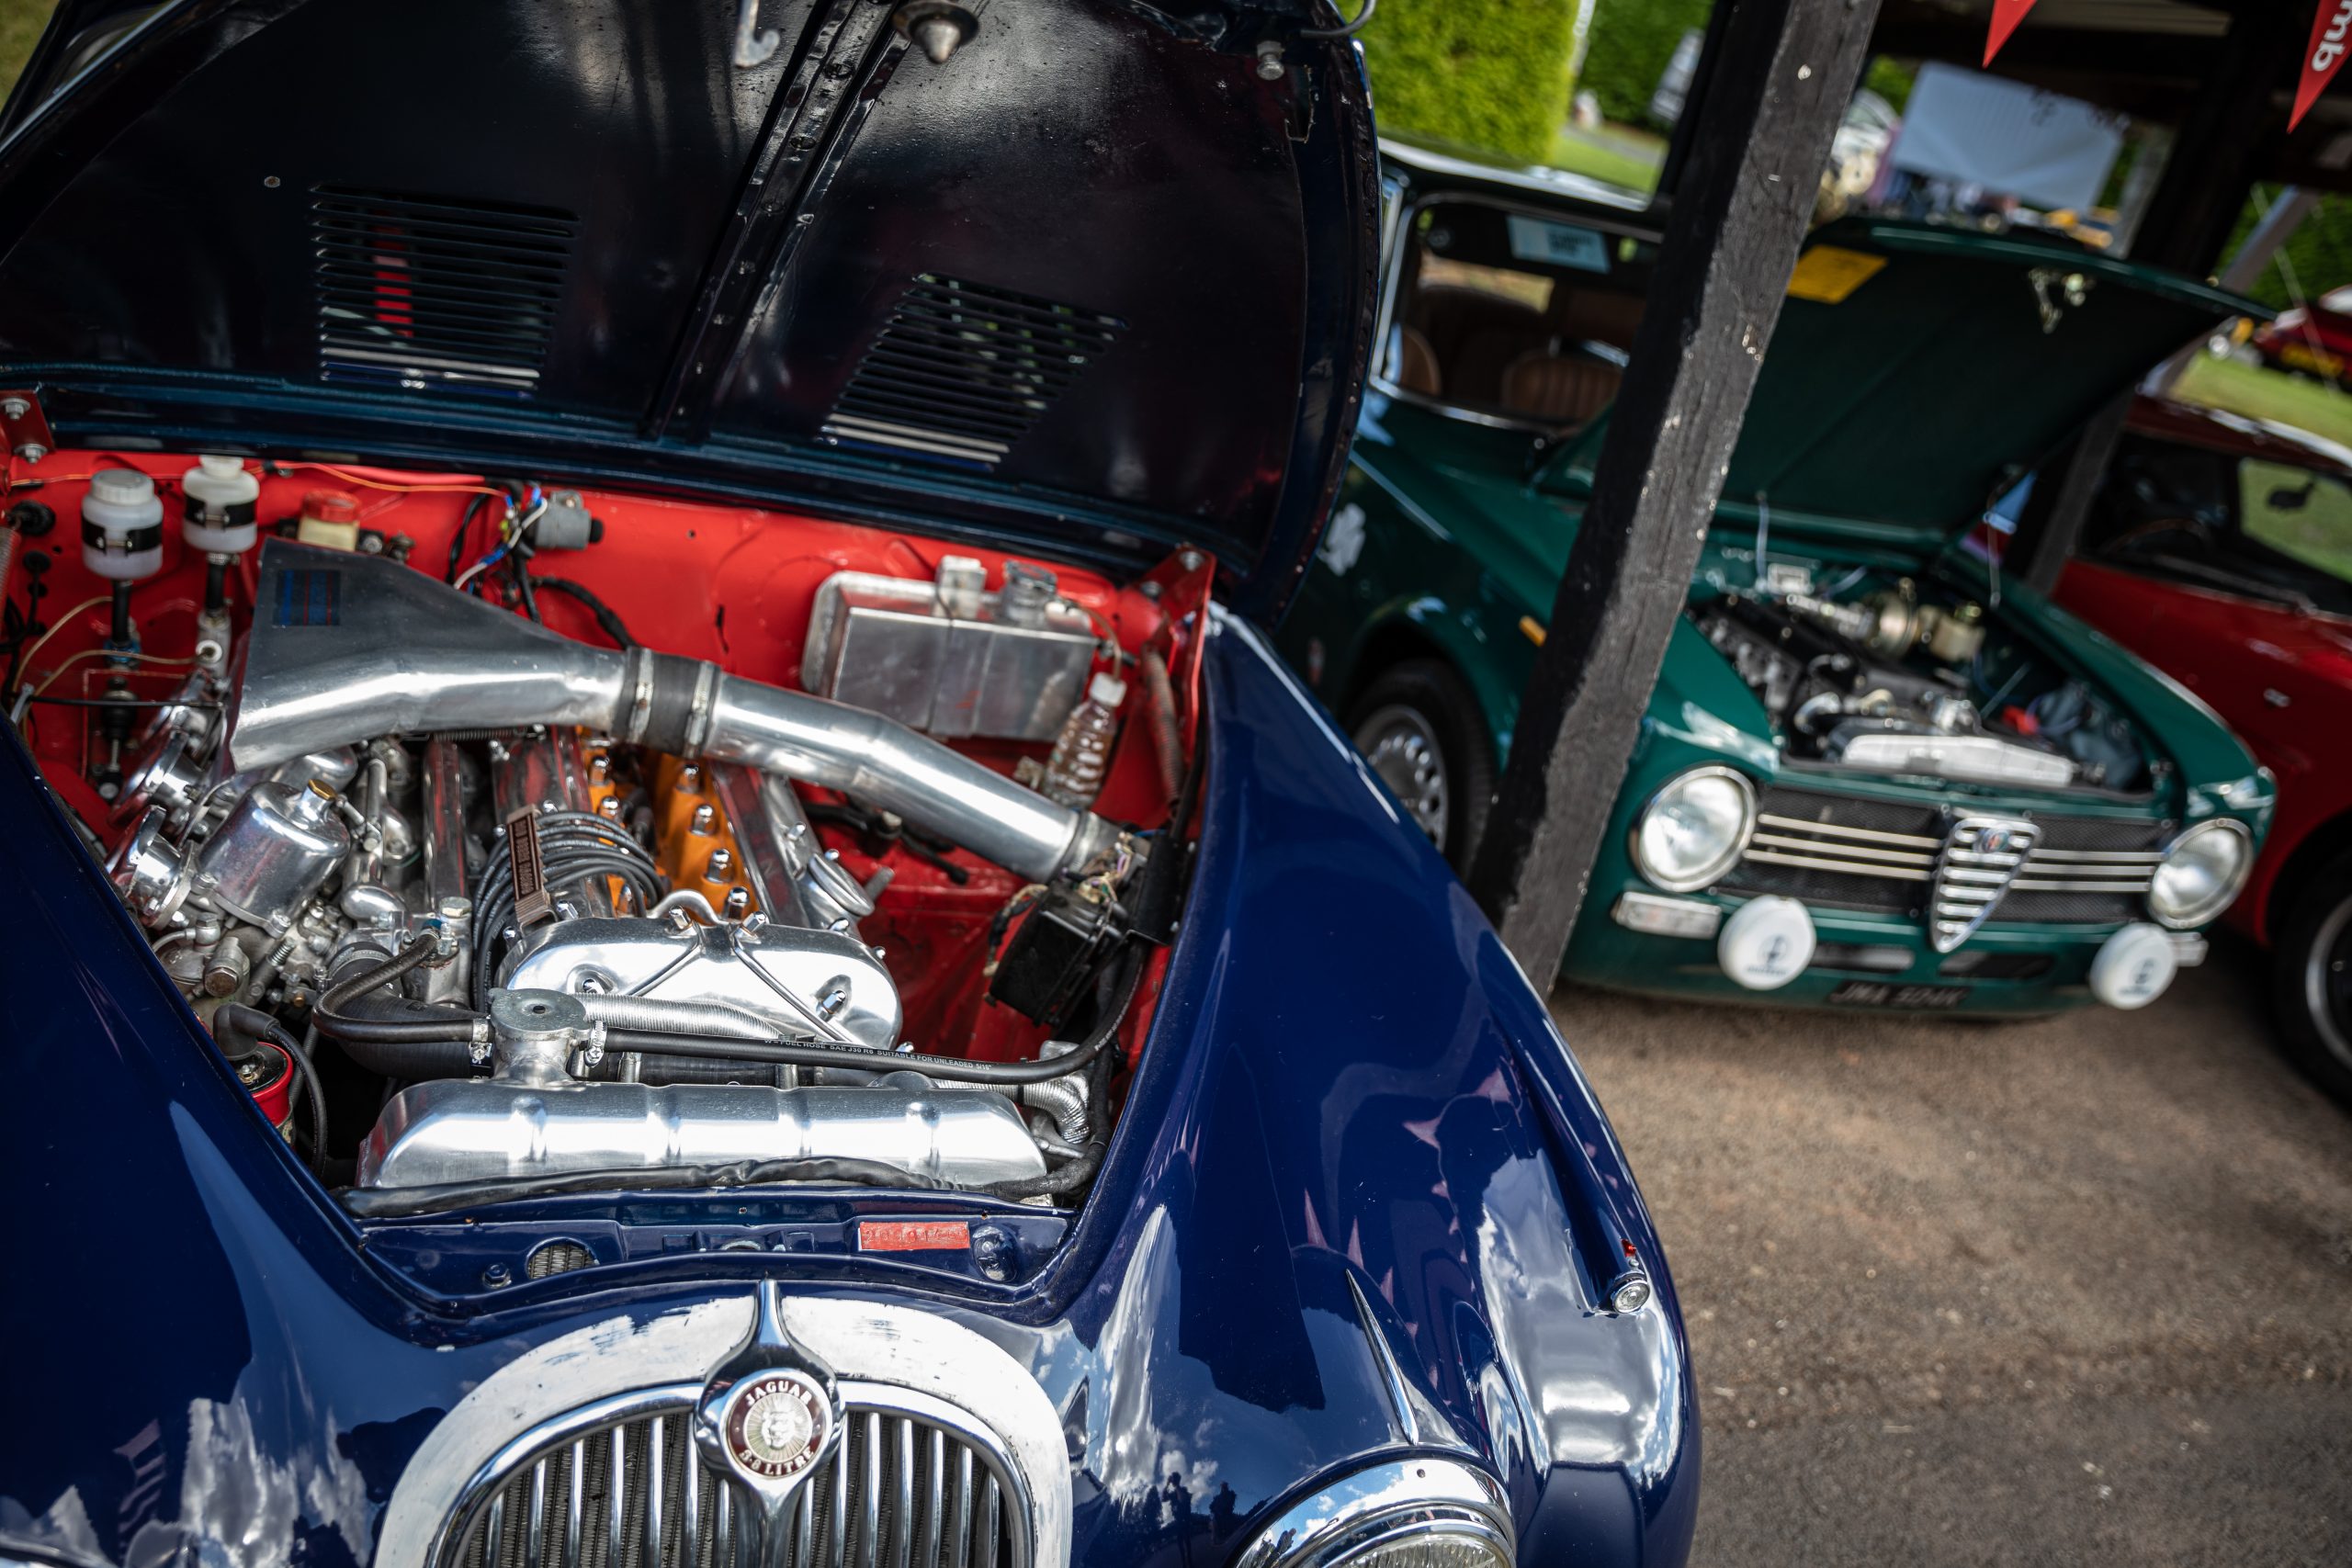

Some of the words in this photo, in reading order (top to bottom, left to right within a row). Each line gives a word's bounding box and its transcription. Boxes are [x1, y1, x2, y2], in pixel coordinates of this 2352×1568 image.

[876, 1050, 916, 1060] SUITABLE
[917, 1055, 933, 1063] FOR
[933, 1057, 974, 1068] UNLEADED
[744, 1380, 812, 1407] JAGUAR
[764, 1446, 815, 1476] LITRE
